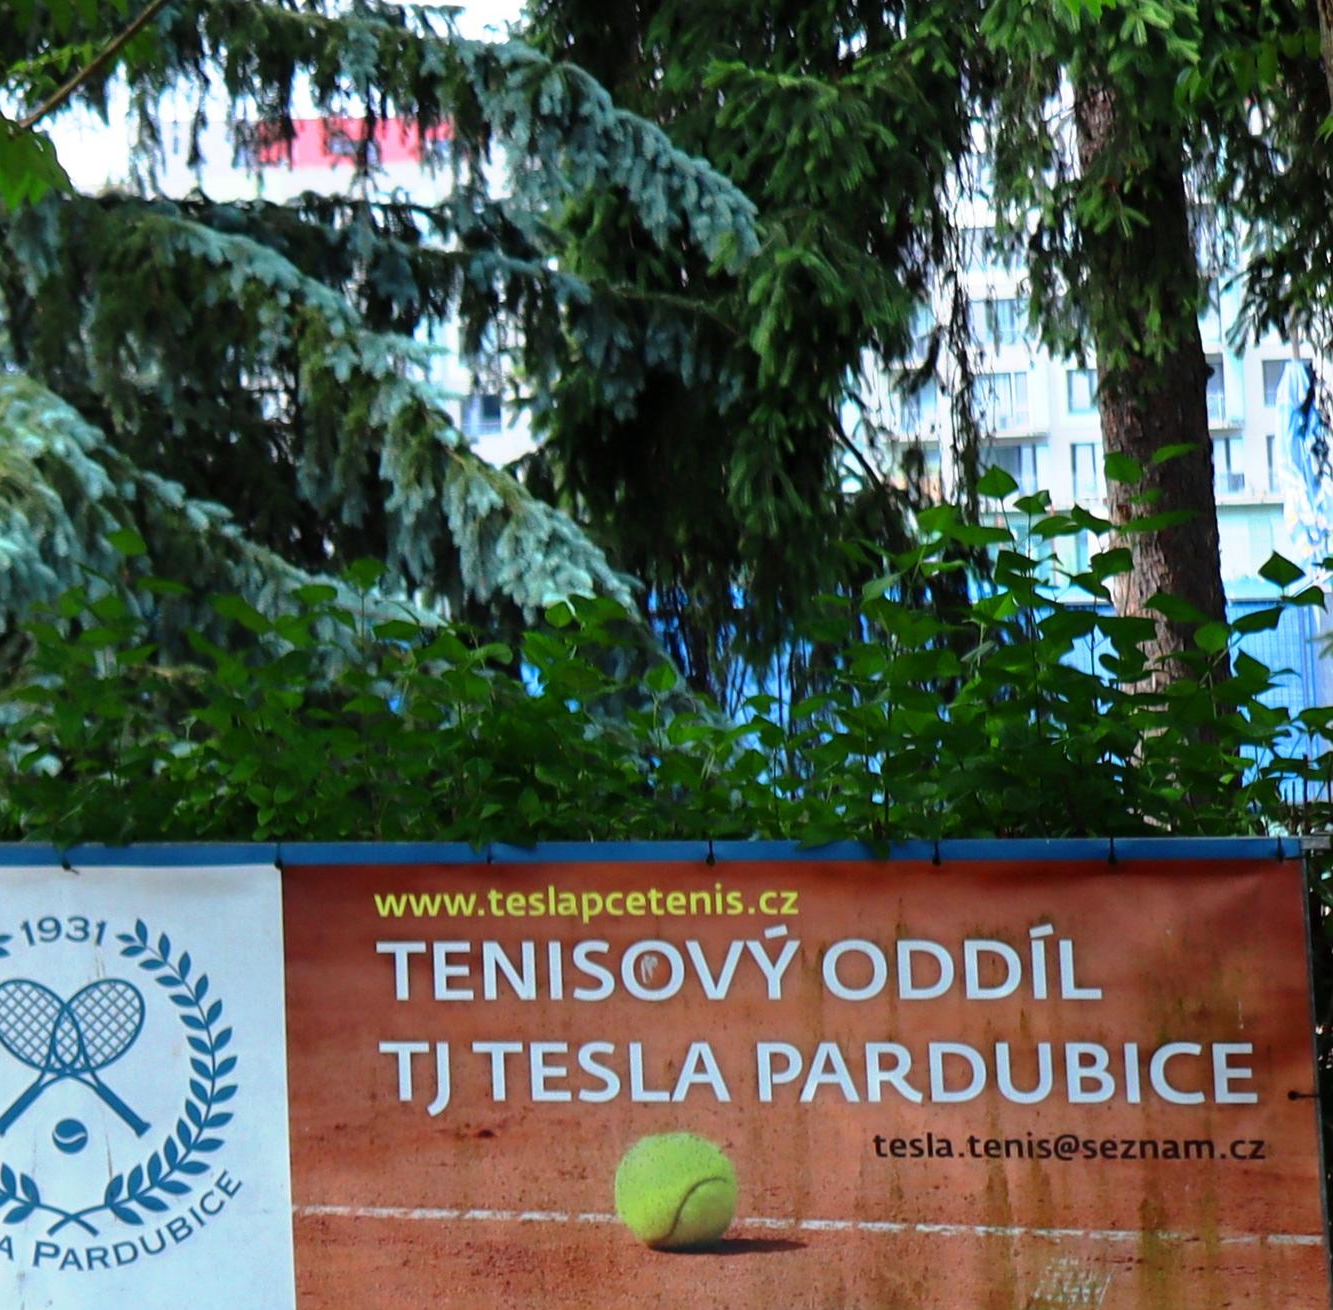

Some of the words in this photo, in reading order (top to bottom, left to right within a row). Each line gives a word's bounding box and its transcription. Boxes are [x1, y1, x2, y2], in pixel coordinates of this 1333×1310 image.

[19, 914, 107, 948] 1931
[373, 883, 800, 924] www.teslapcetenis.cz
[375, 923, 801, 1002] TENISOVÝ
[822, 923, 1102, 1002] ODDÍL
[378, 1041, 454, 1117] TJ
[466, 1041, 731, 1105] TESLA
[758, 1041, 1260, 1107] PARDUBICE
[873, 1131, 1267, 1163] tesla.tenis@seznam.cz
[32, 1169, 245, 1274] PARDUBICE
